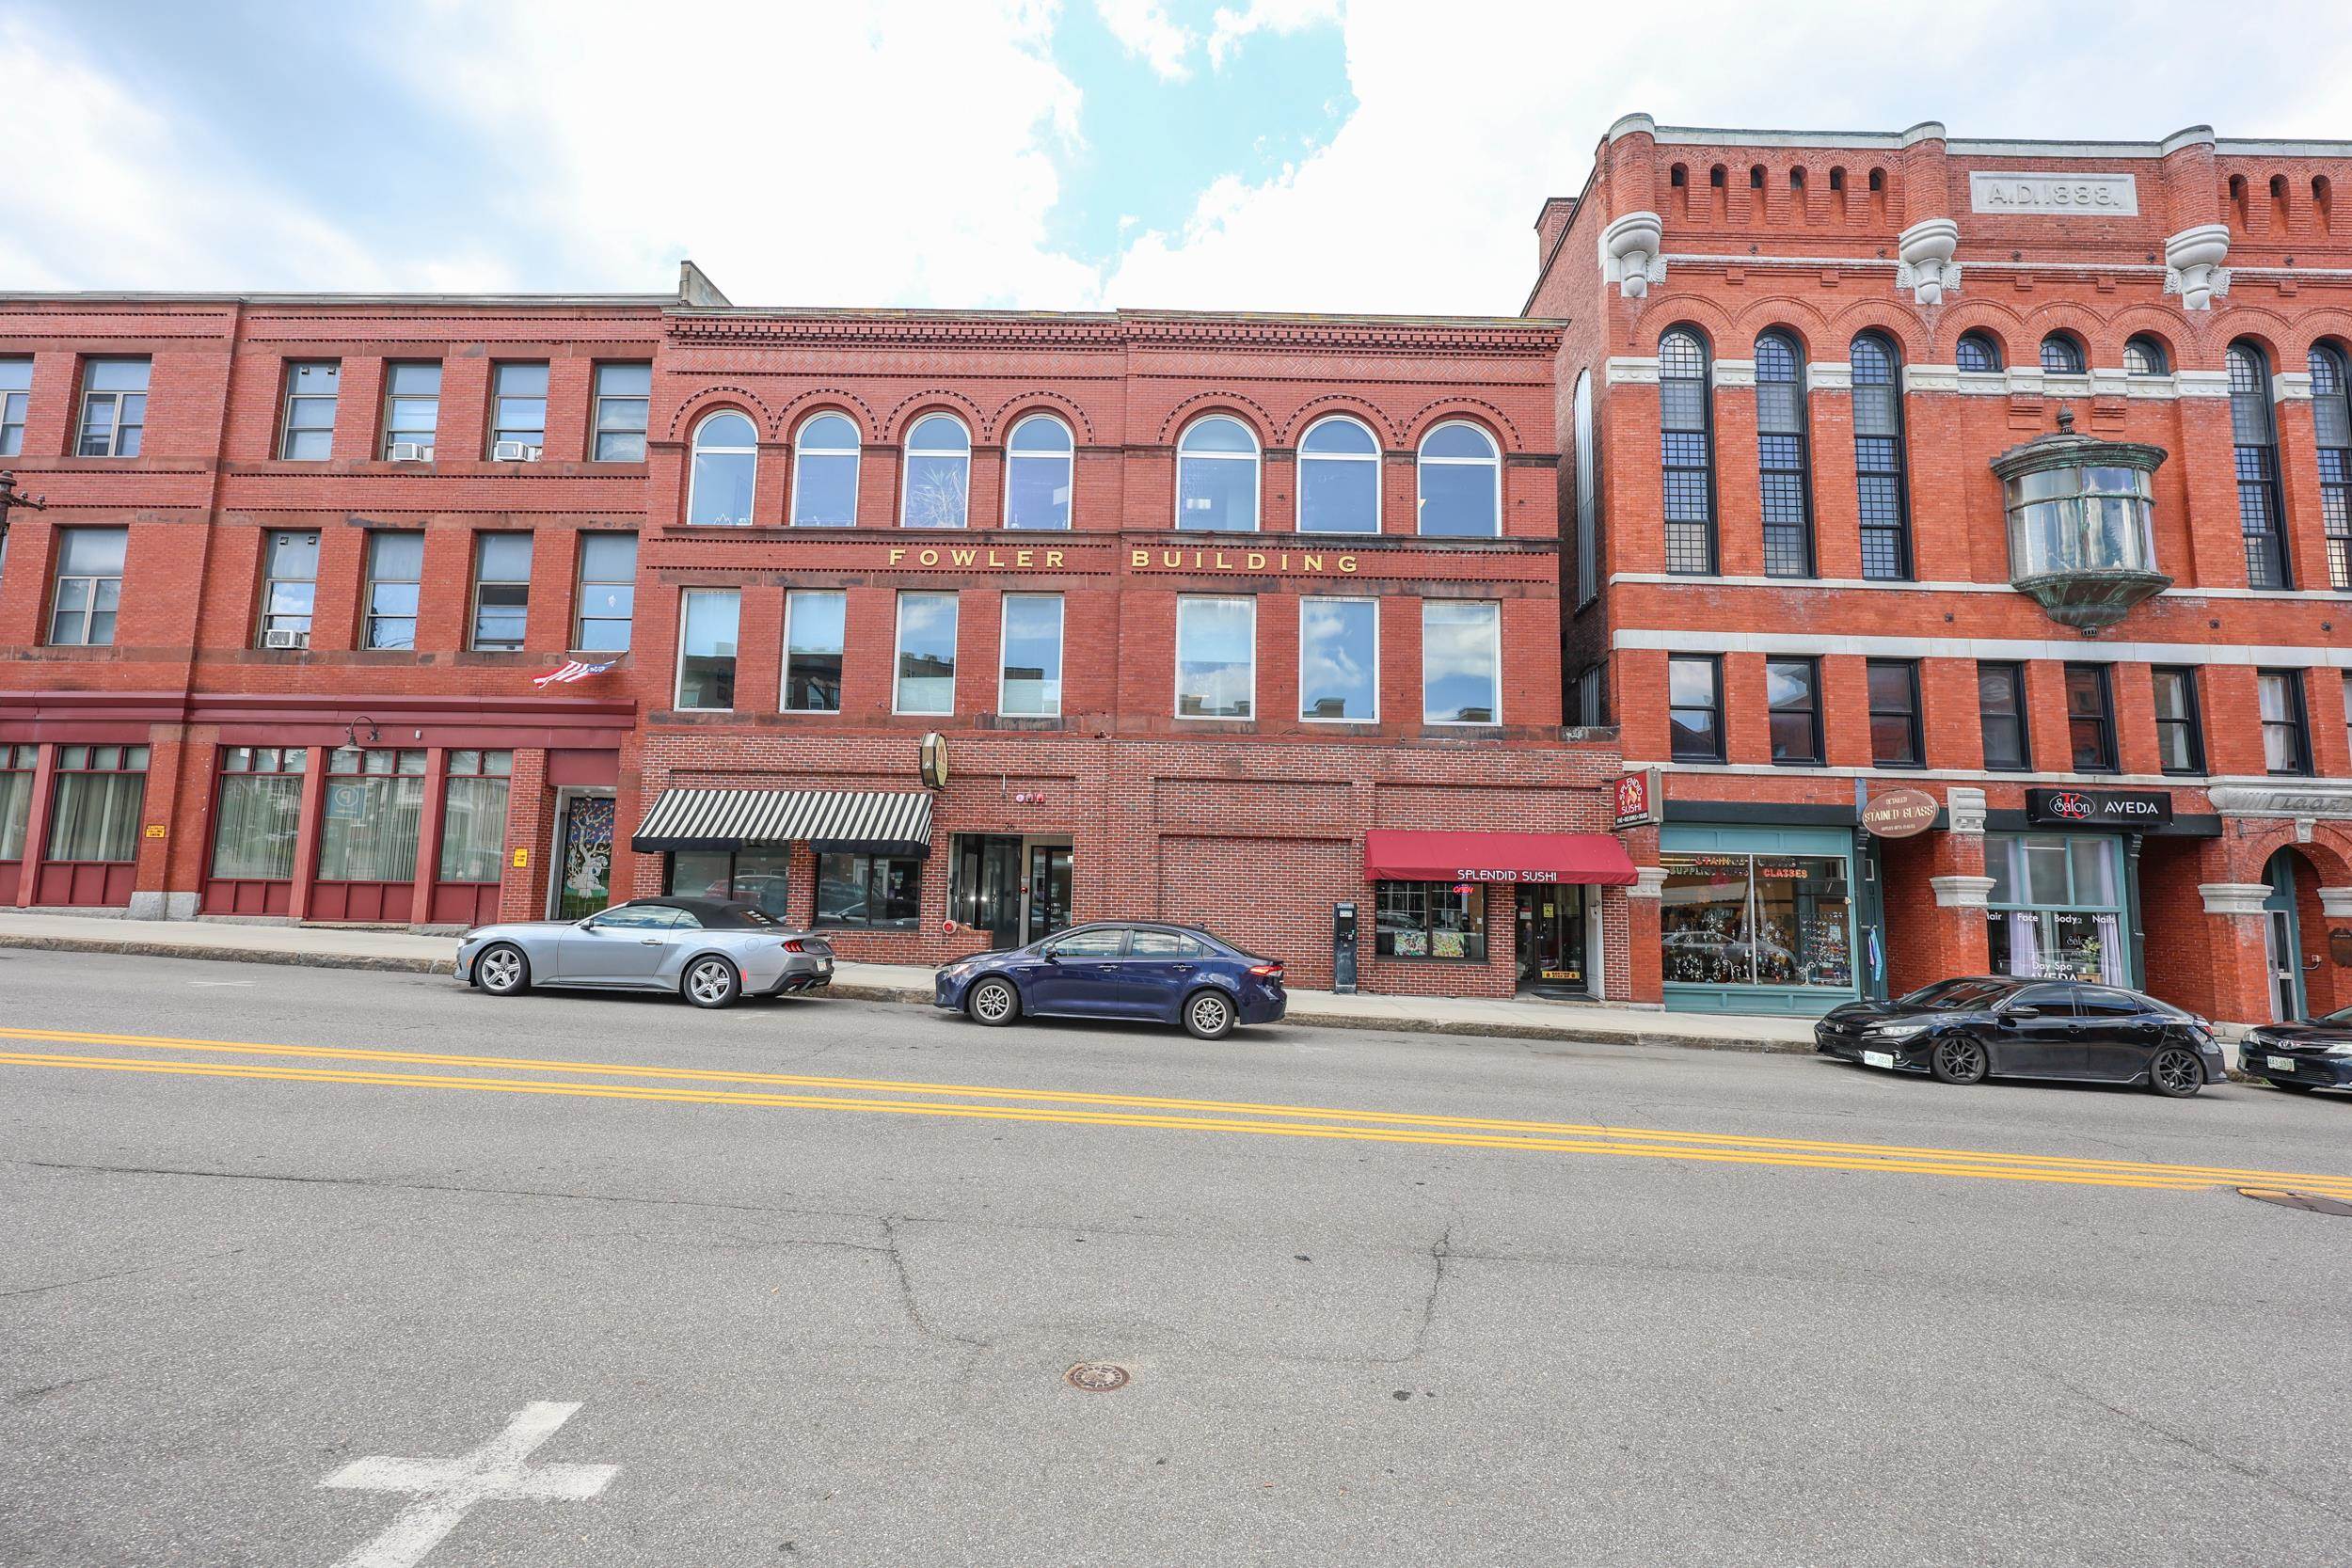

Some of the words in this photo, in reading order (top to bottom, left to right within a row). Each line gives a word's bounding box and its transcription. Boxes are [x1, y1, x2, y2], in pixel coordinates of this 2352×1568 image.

[889, 548, 1064, 567] FOWLER
[1132, 550, 1357, 572] BUILDING
[1619, 777, 1643, 800] SPLENDID
[1621, 802, 1642, 815] SUSHI
[2054, 798, 2090, 814] Salon
[2104, 801, 2159, 815] AVEDA
[1864, 809, 1899, 823] STAINED
[1902, 805, 1933, 818] GLASS
[1457, 869, 1517, 880] SPLENDID
[1522, 871, 1557, 882] SUSHI
[1763, 868, 1808, 879] CLASSES
[1453, 885, 1473, 894] OPEN
[2017, 913, 2039, 923] Face
[2055, 914, 2077, 925] Body
[2092, 915, 2116, 924] Nails
[2032, 961, 2051, 972] Day
[2054, 962, 2073, 973] Spa
